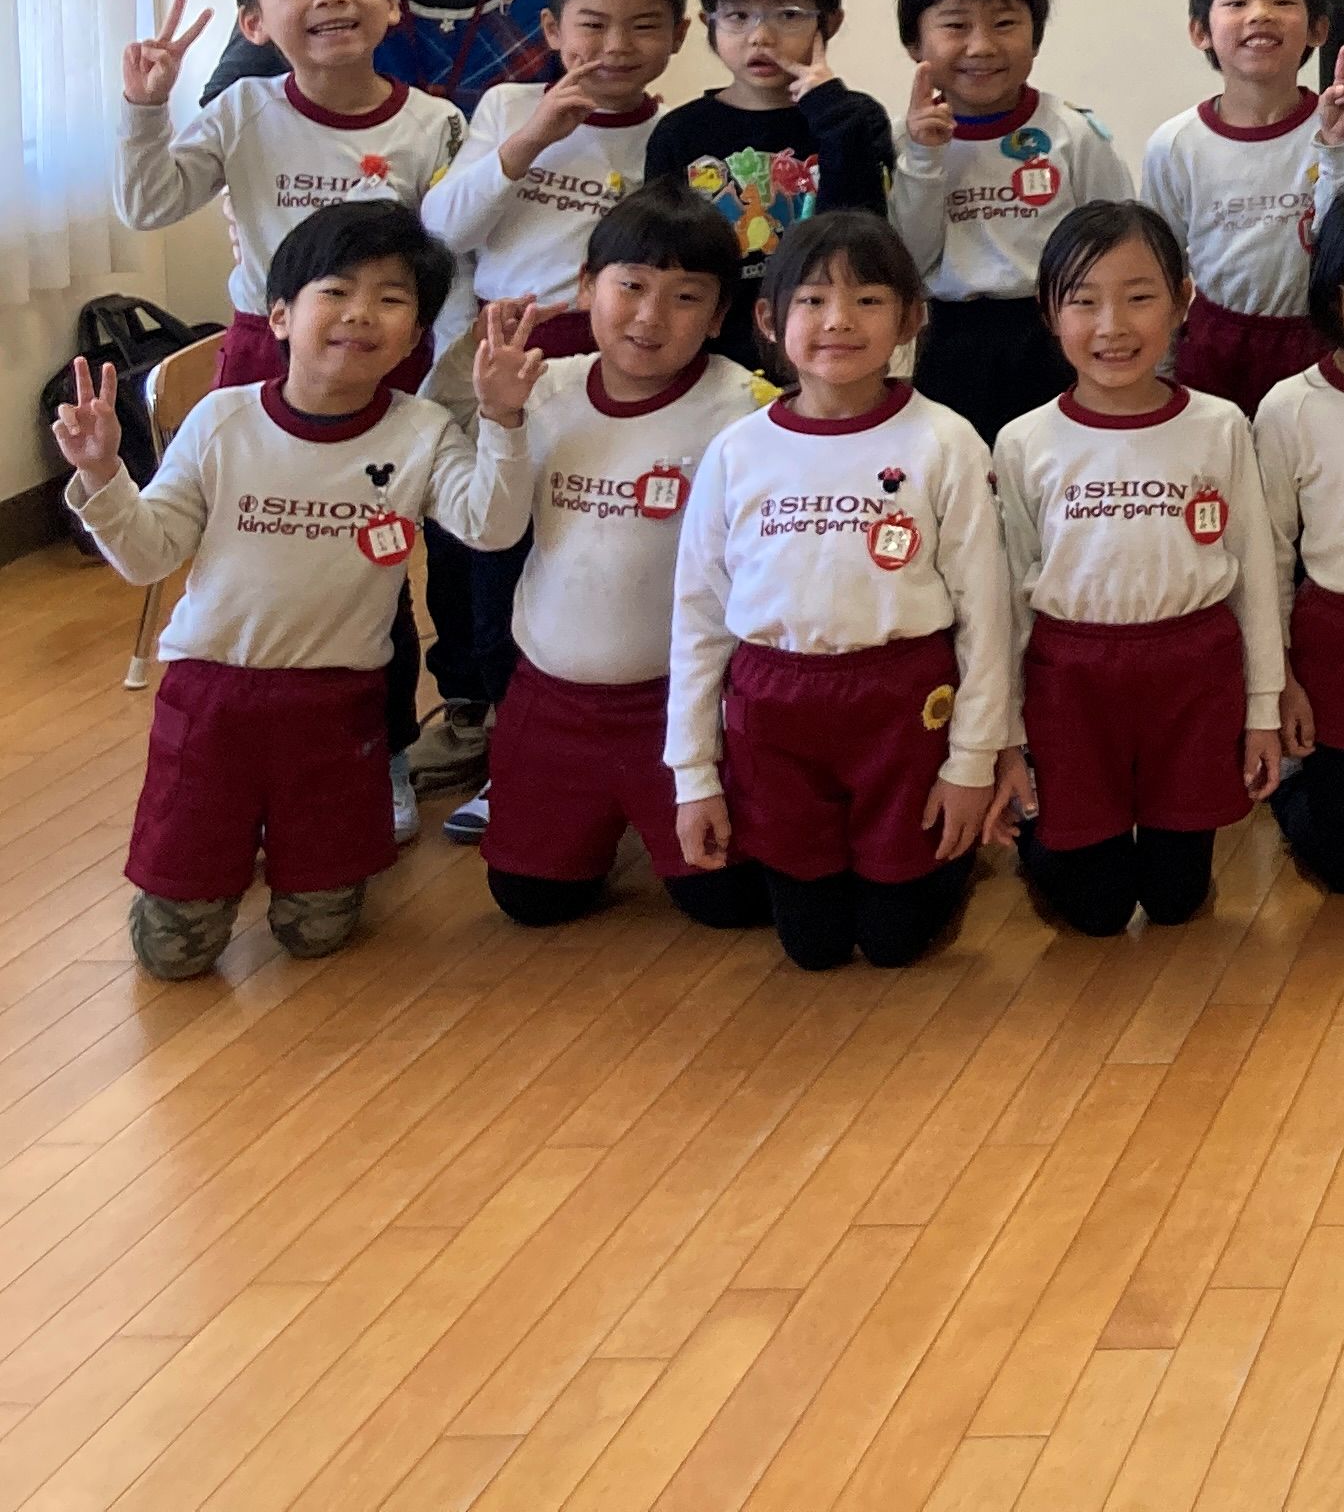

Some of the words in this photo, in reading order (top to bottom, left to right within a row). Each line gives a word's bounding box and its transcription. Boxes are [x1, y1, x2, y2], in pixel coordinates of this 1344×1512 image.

[294, 174, 361, 191] SHI
[517, 188, 612, 216] ndergarte
[951, 186, 1016, 205] SHIO
[566, 474, 637, 498] SHIO
[1085, 480, 1188, 499] SHION
[551, 490, 640, 518] kindergart
[779, 495, 884, 514] SHION
[237, 514, 359, 539] kindergart
[760, 516, 870, 537] kindergarte
